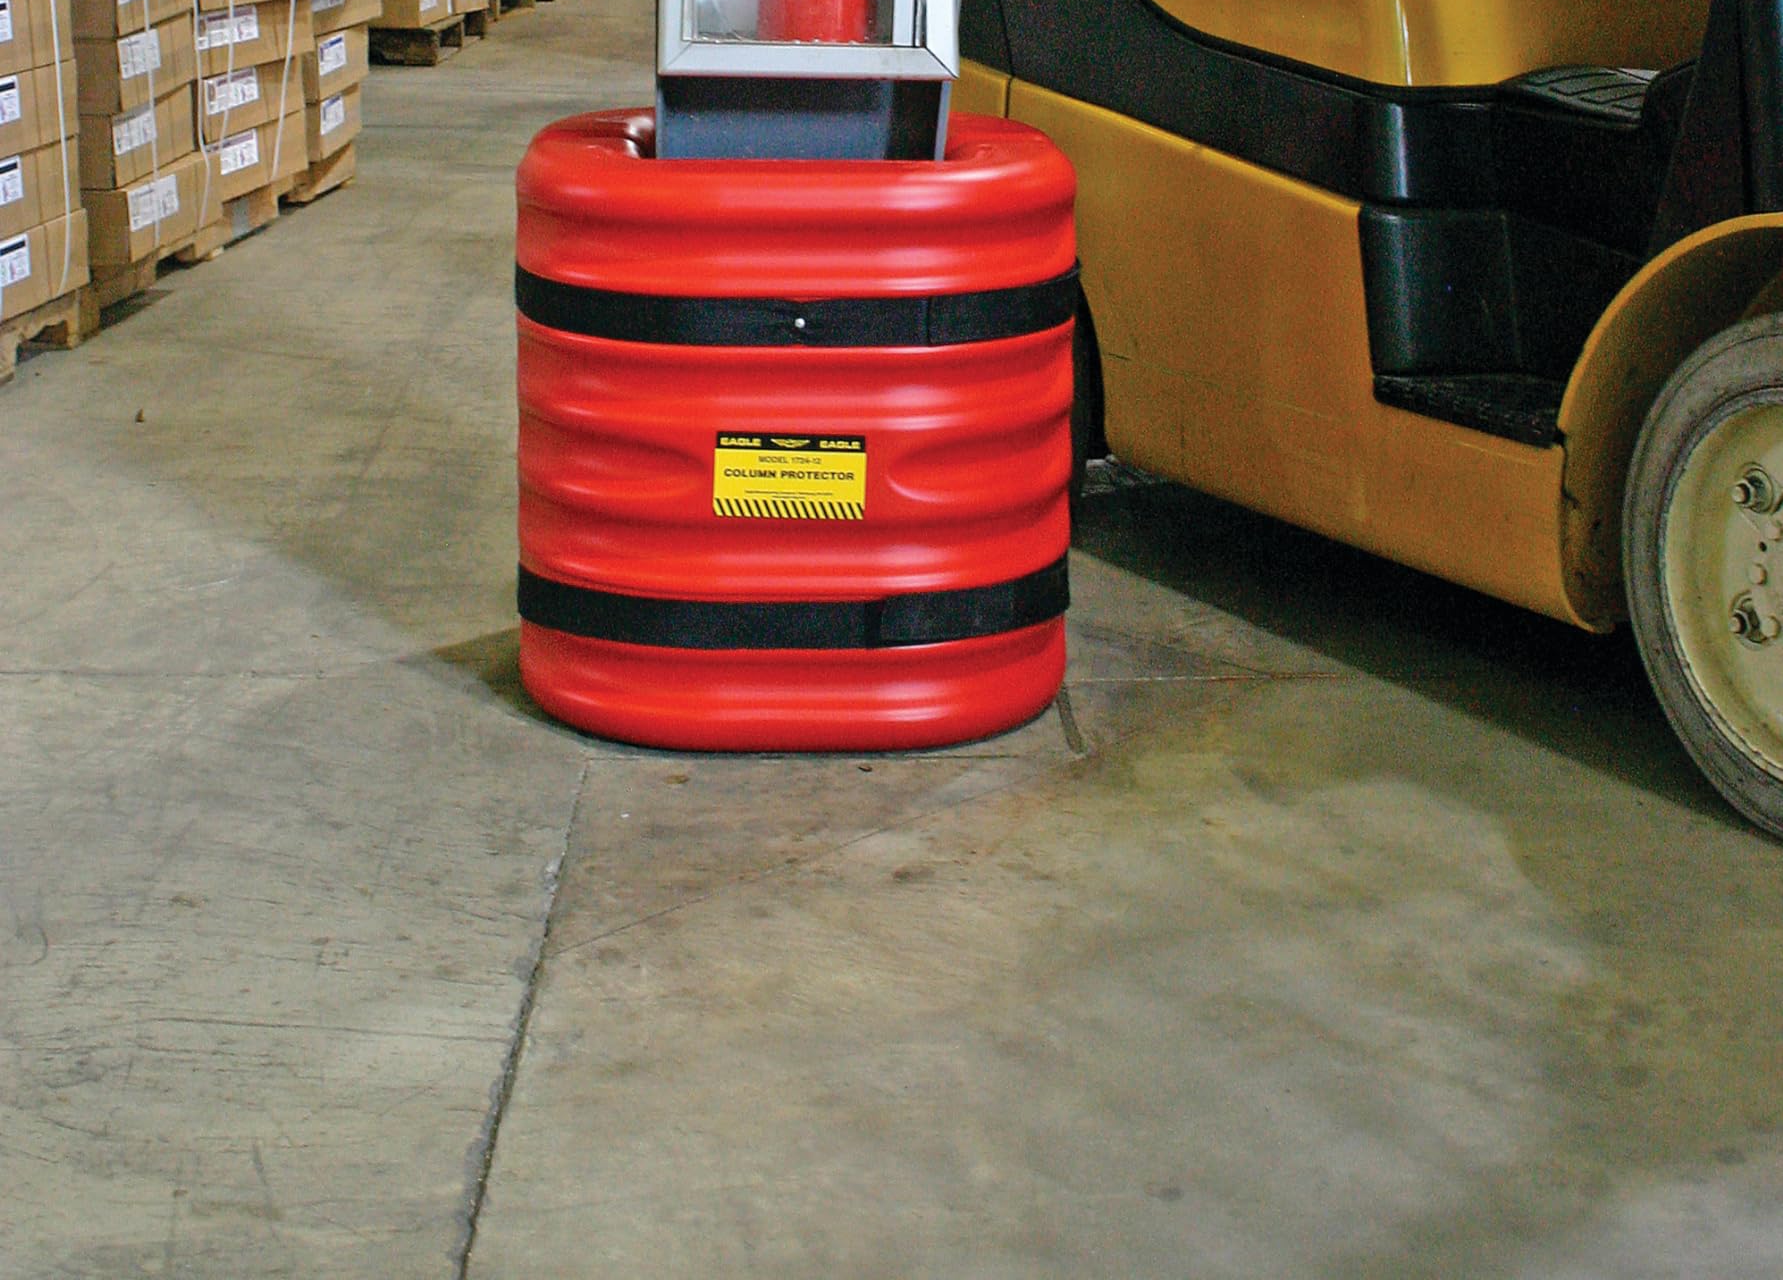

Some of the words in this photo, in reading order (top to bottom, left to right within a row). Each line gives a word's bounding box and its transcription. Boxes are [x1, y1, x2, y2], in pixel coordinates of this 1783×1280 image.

[720, 437, 762, 447] EAGLE
[819, 440, 861, 450] EAGLE
[758, 455, 788, 464] MODEL
[723, 468, 776, 479] COLUMN
[780, 470, 855, 481] PROTECTOR
